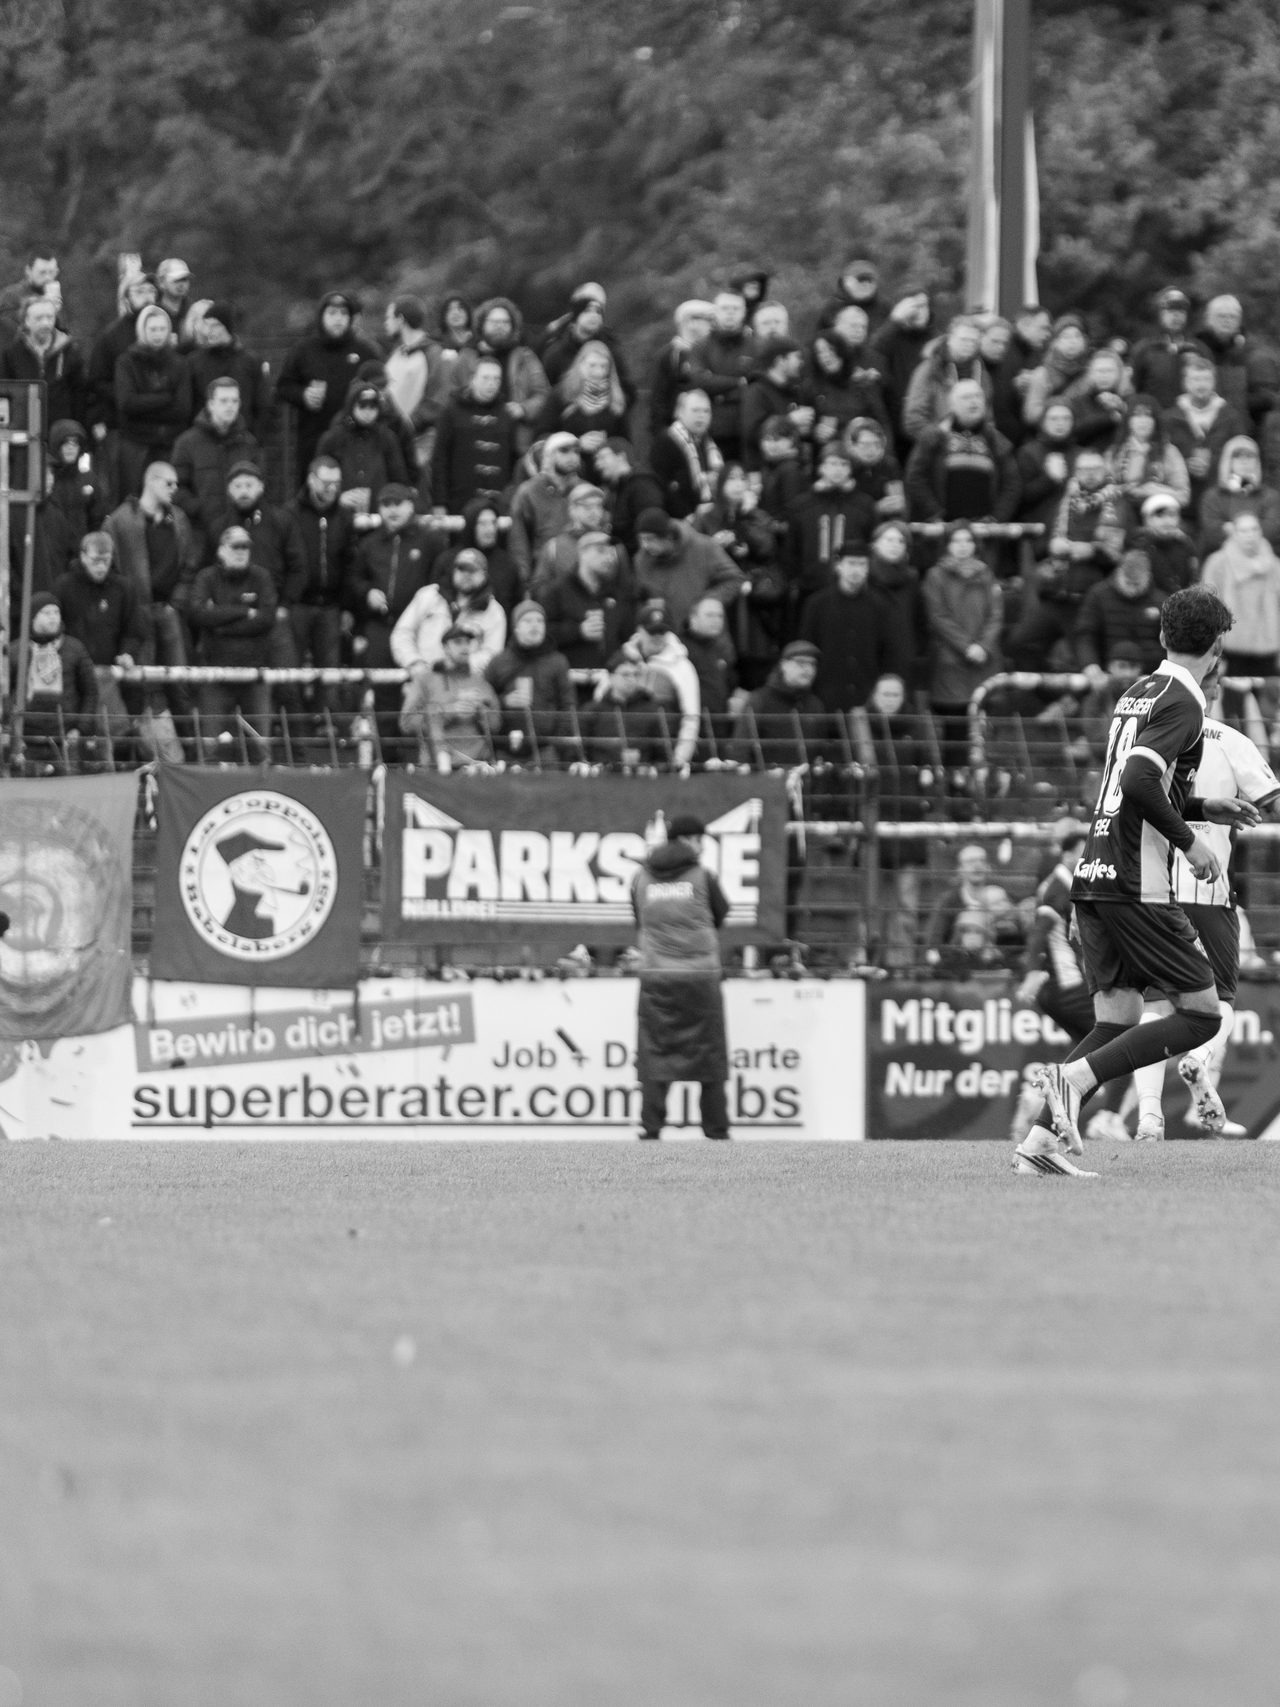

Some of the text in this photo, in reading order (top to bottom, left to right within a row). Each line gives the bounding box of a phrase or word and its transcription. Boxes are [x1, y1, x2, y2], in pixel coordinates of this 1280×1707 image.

[149, 1021, 277, 1064] Bewirb
[370, 1001, 463, 1049] jetzt!
[492, 1040, 558, 1069] Job
[884, 1063, 952, 1097] Nur
[955, 1062, 1018, 1097] der
